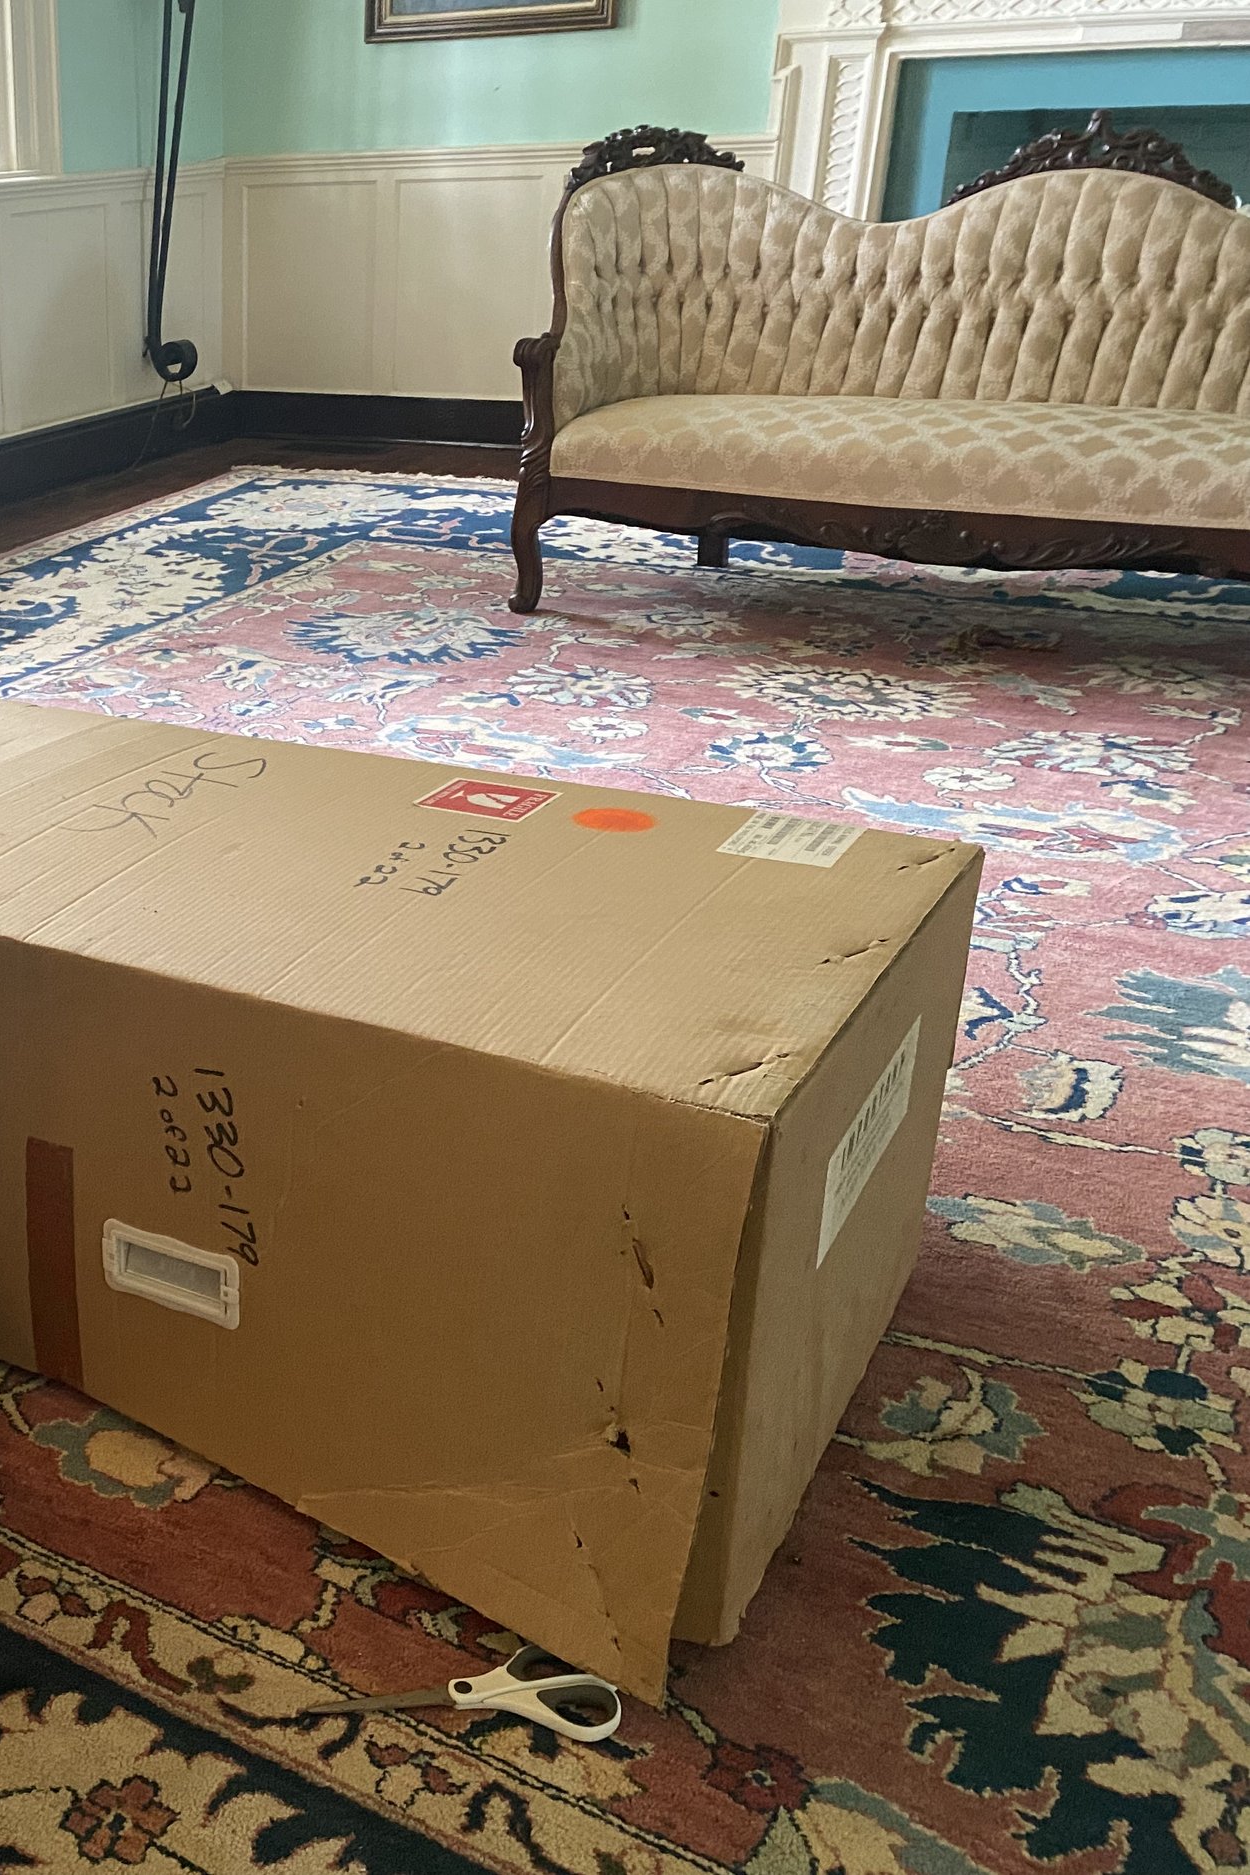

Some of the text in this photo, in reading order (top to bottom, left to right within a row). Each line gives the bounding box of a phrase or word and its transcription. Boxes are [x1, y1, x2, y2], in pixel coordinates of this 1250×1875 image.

[502, 793, 549, 817] FRAGILE
[152, 1075, 192, 1195] 2 of 22
[193, 1067, 259, 1267] 1330-179
